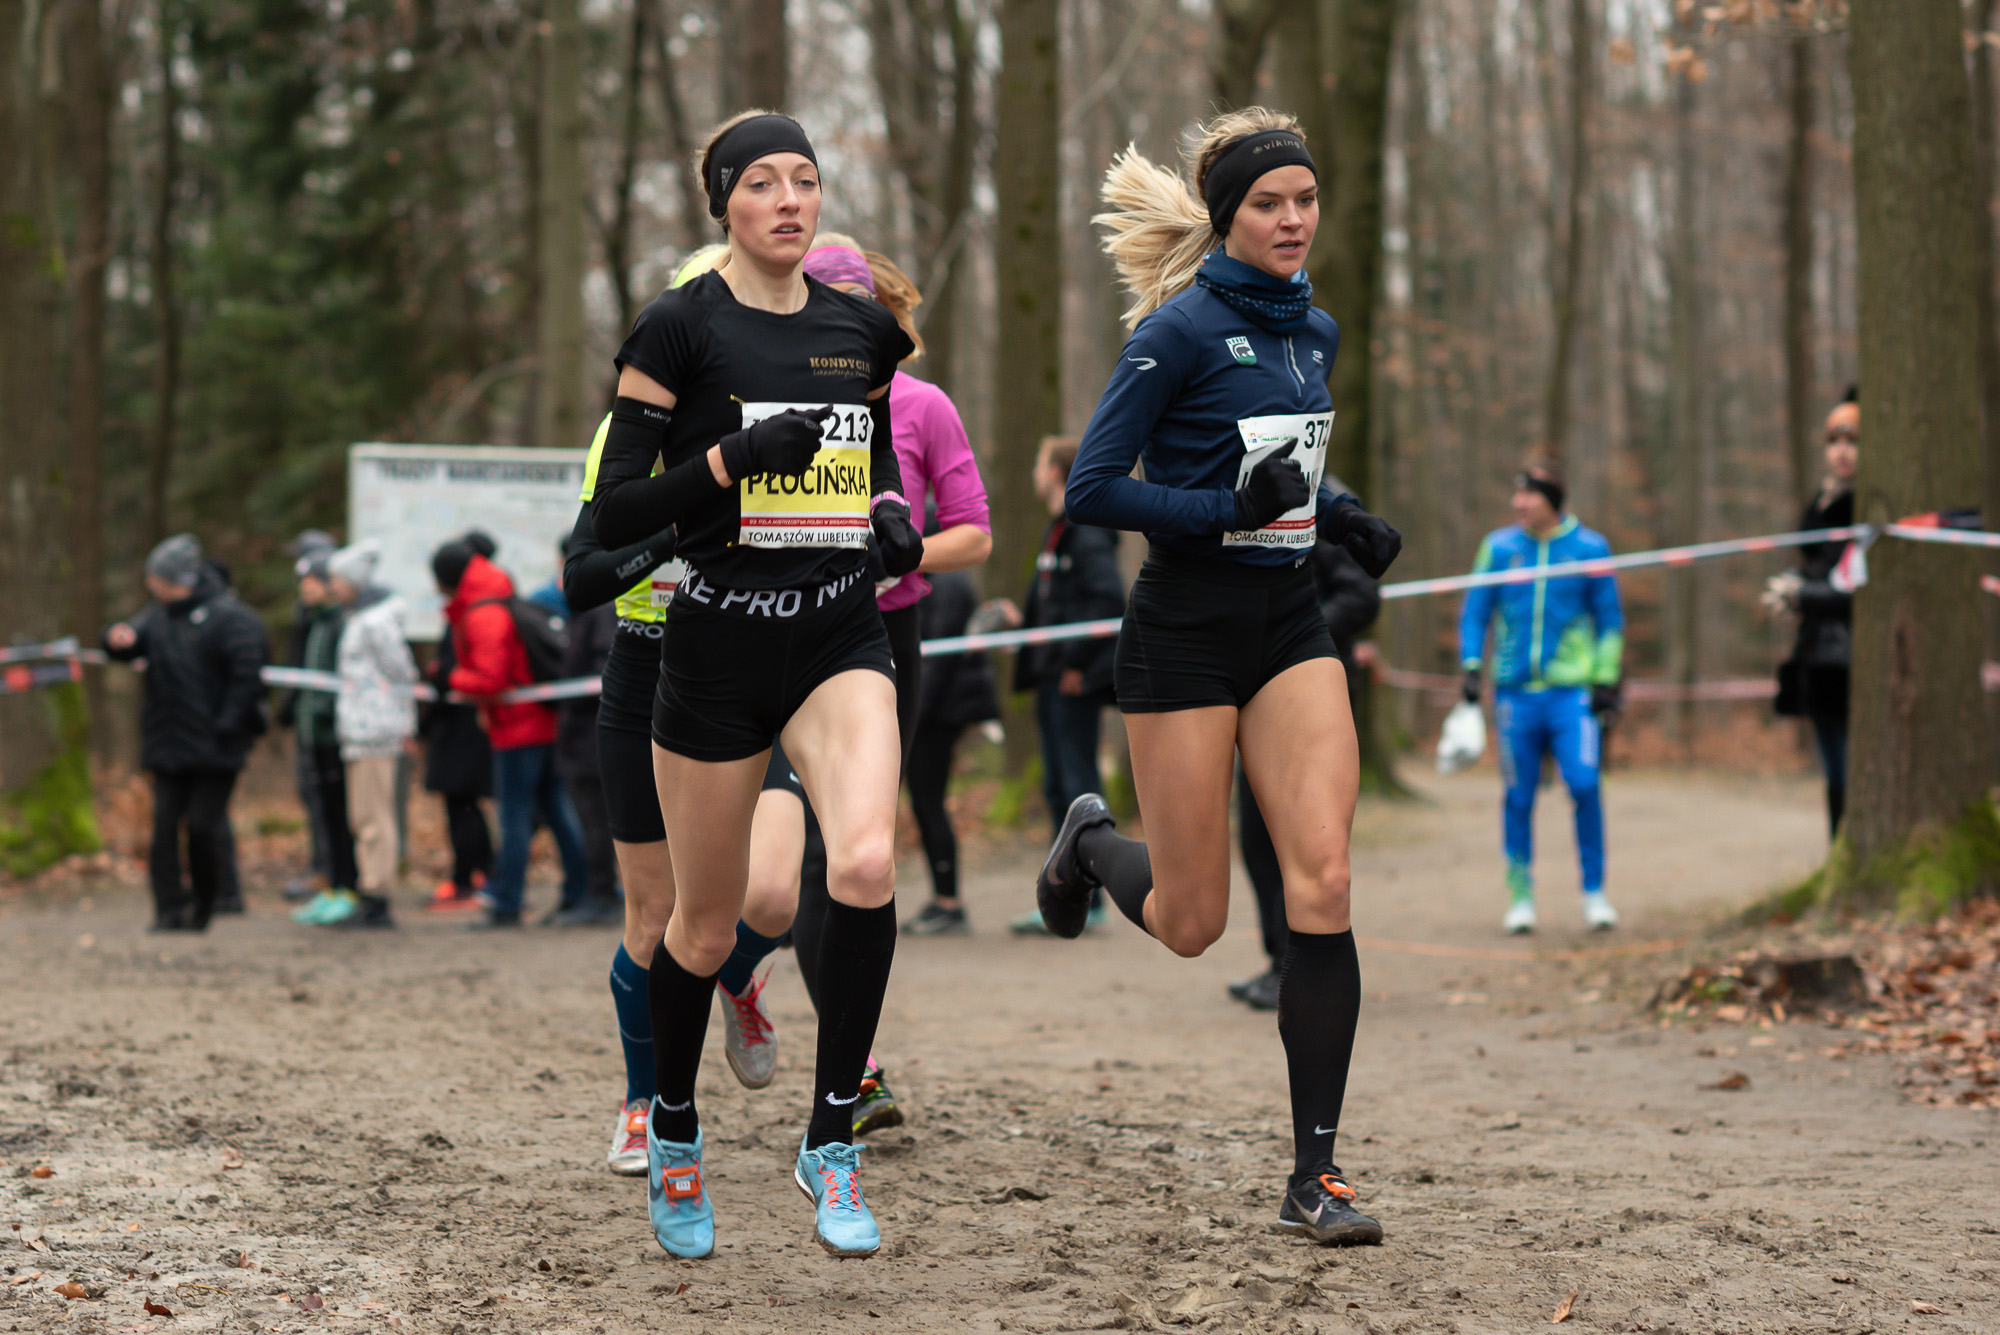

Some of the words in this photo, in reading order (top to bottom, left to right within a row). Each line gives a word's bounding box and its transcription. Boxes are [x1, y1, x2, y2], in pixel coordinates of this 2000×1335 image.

[1263, 138, 1300, 150] viking
[825, 411, 869, 443] 213
[747, 457, 868, 497] PŁOCIŃSKA
[748, 530, 815, 544] TOMASZÓW
[817, 532, 859, 543] LUBELSKI
[1229, 531, 1286, 544] TOMASZÓW
[720, 589, 802, 618] PRO
[617, 617, 664, 640] PRO
